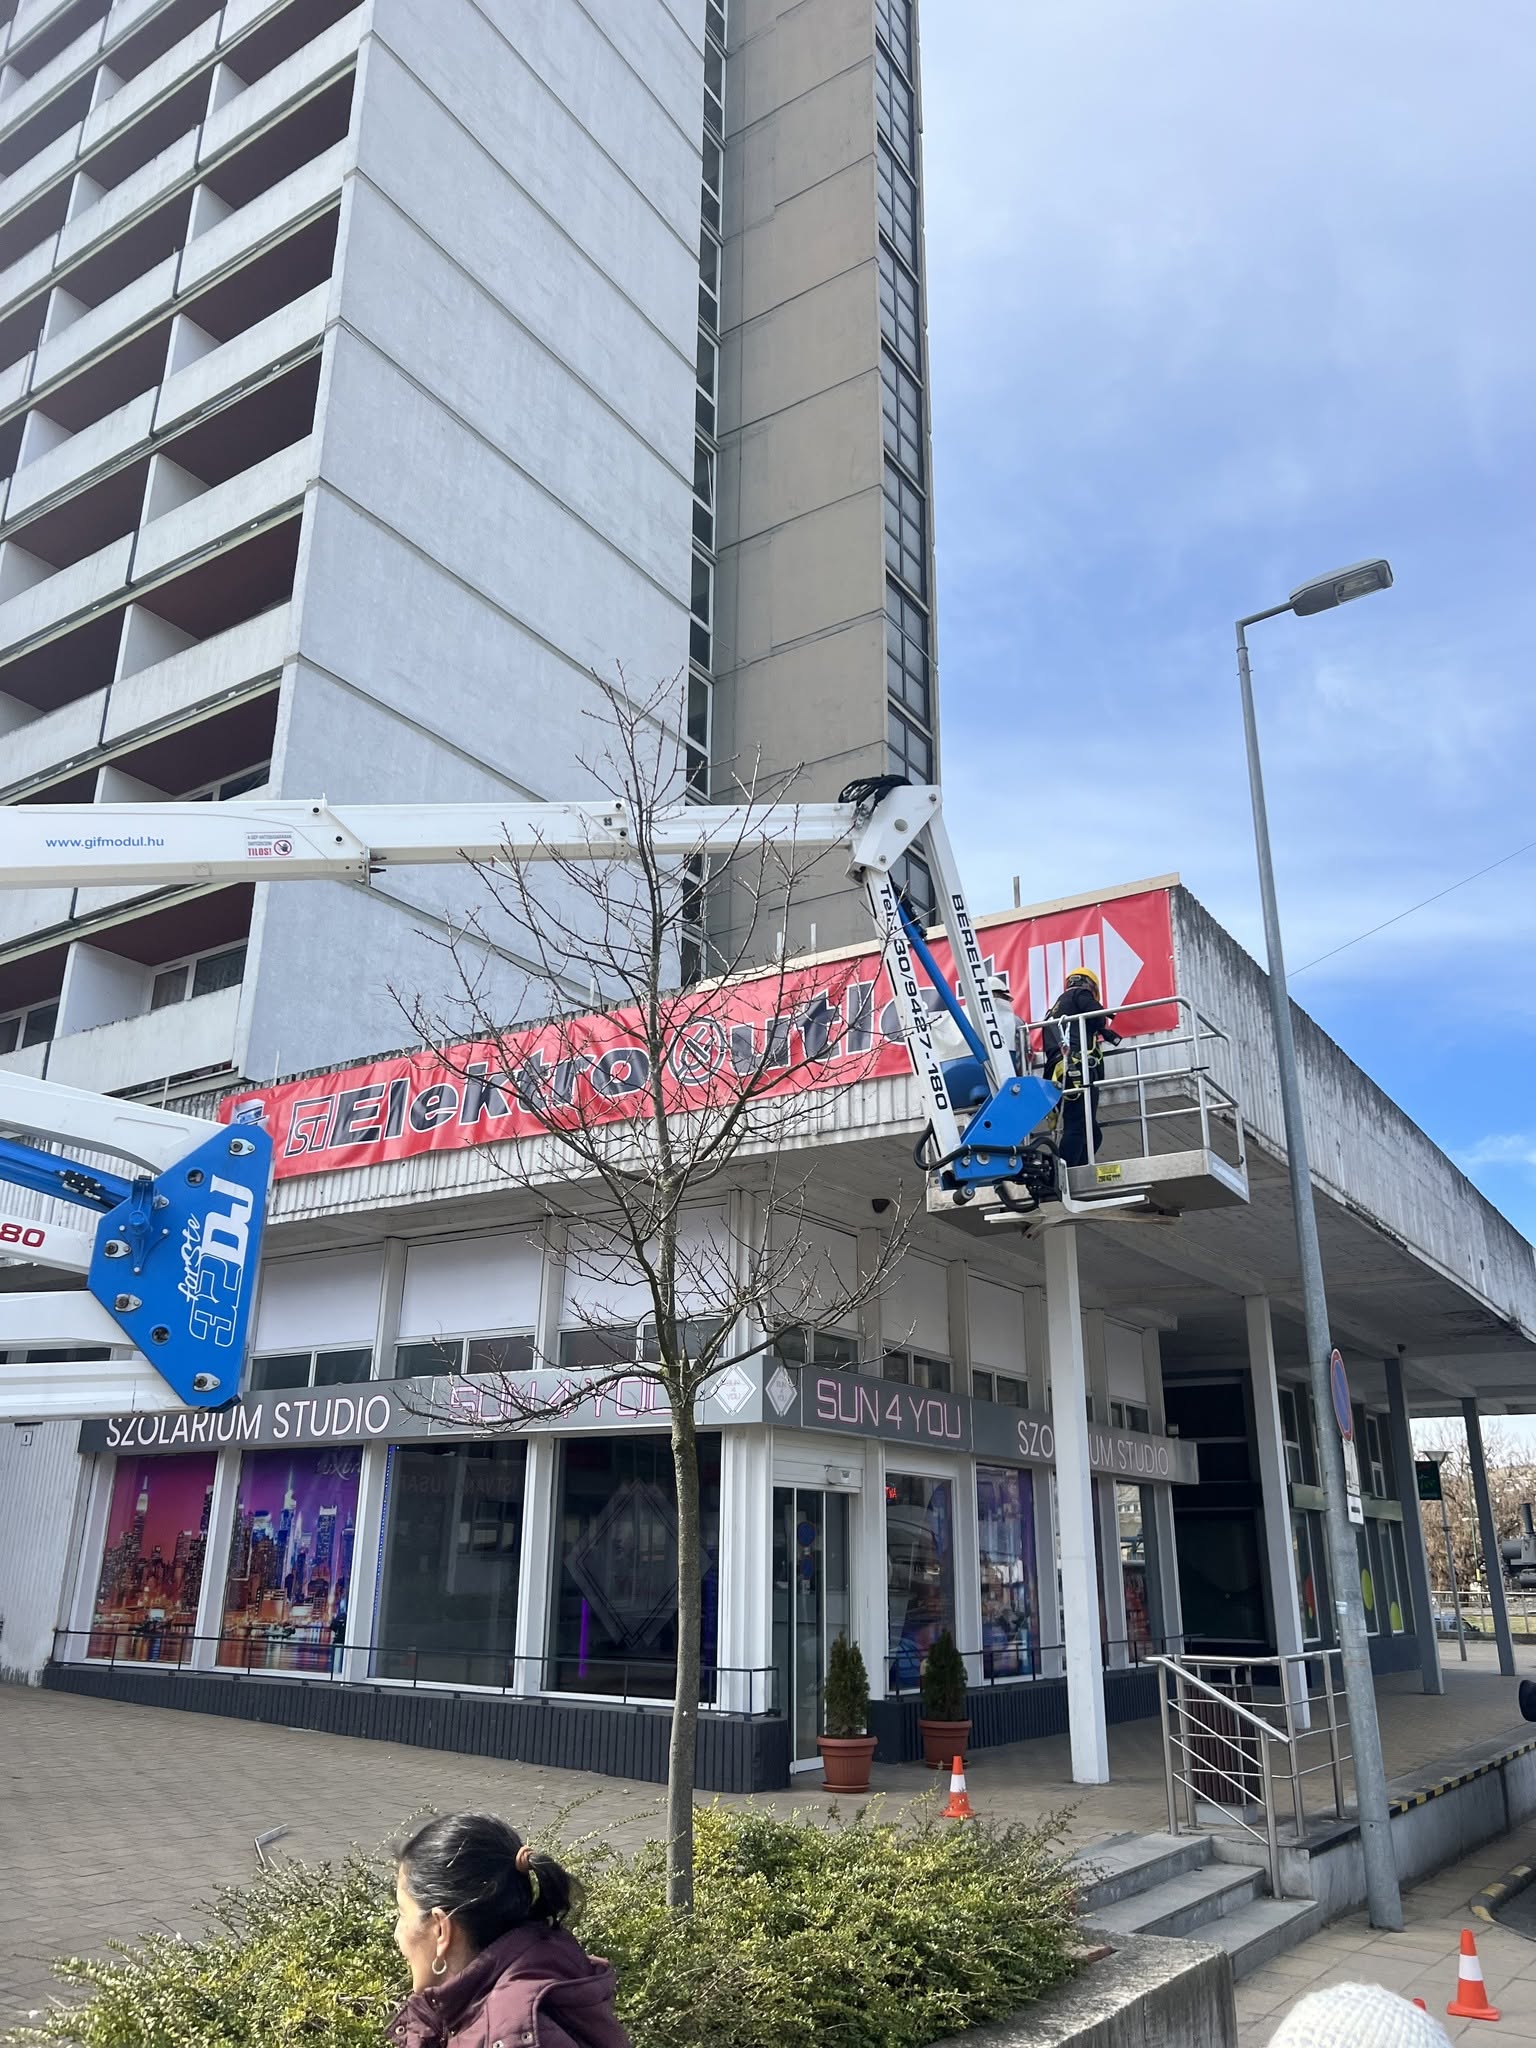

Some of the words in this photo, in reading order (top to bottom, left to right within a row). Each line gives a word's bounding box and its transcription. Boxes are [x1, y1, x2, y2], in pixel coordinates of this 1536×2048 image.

[45, 836, 164, 850] www.gifmodul.hu
[247, 847, 272, 857] TILOS!
[951, 893, 1006, 1050] BÉRELHETŐ
[893, 938, 948, 1111] 30/9427-180
[327, 1046, 652, 1150] Elektro
[106, 1403, 263, 1448] SZOLARIUM
[272, 1394, 391, 1440] STUDIO
[816, 1377, 880, 1428] SUN
[885, 1393, 903, 1431] 4
[908, 1395, 962, 1440] YOU
[1116, 1438, 1170, 1476] STUDIO
